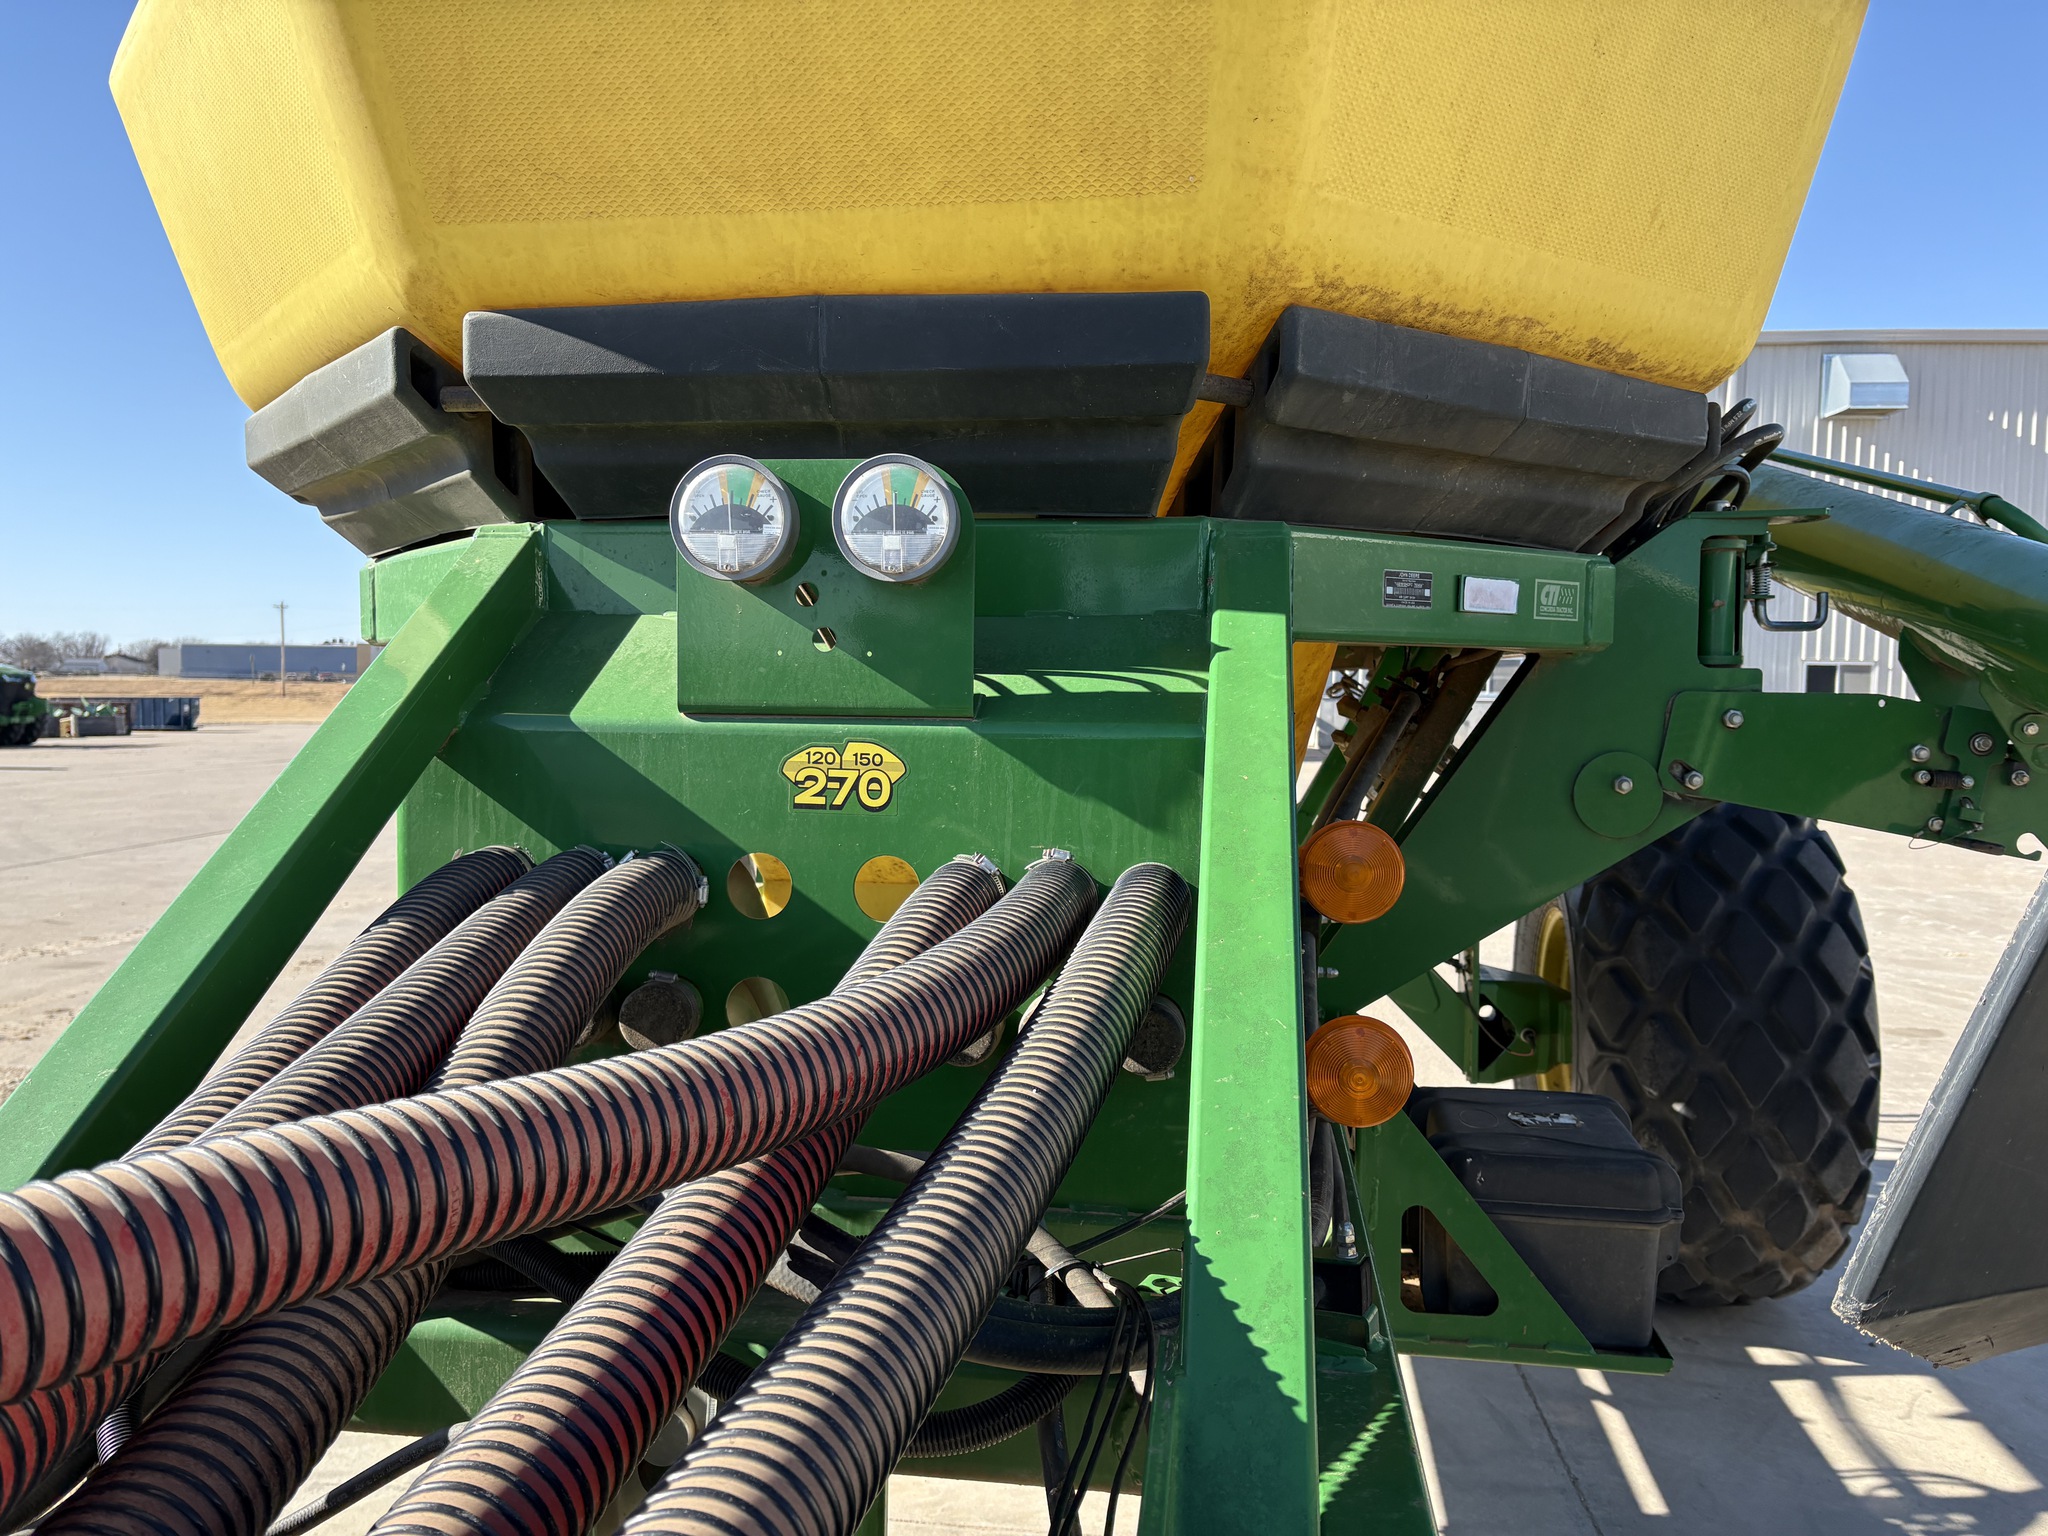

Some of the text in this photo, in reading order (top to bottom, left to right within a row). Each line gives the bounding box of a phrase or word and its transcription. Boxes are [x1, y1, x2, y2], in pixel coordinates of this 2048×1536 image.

[1541, 584, 1561, 606] CTI
[805, 751, 884, 766] 120 150
[793, 767, 893, 812] 270
